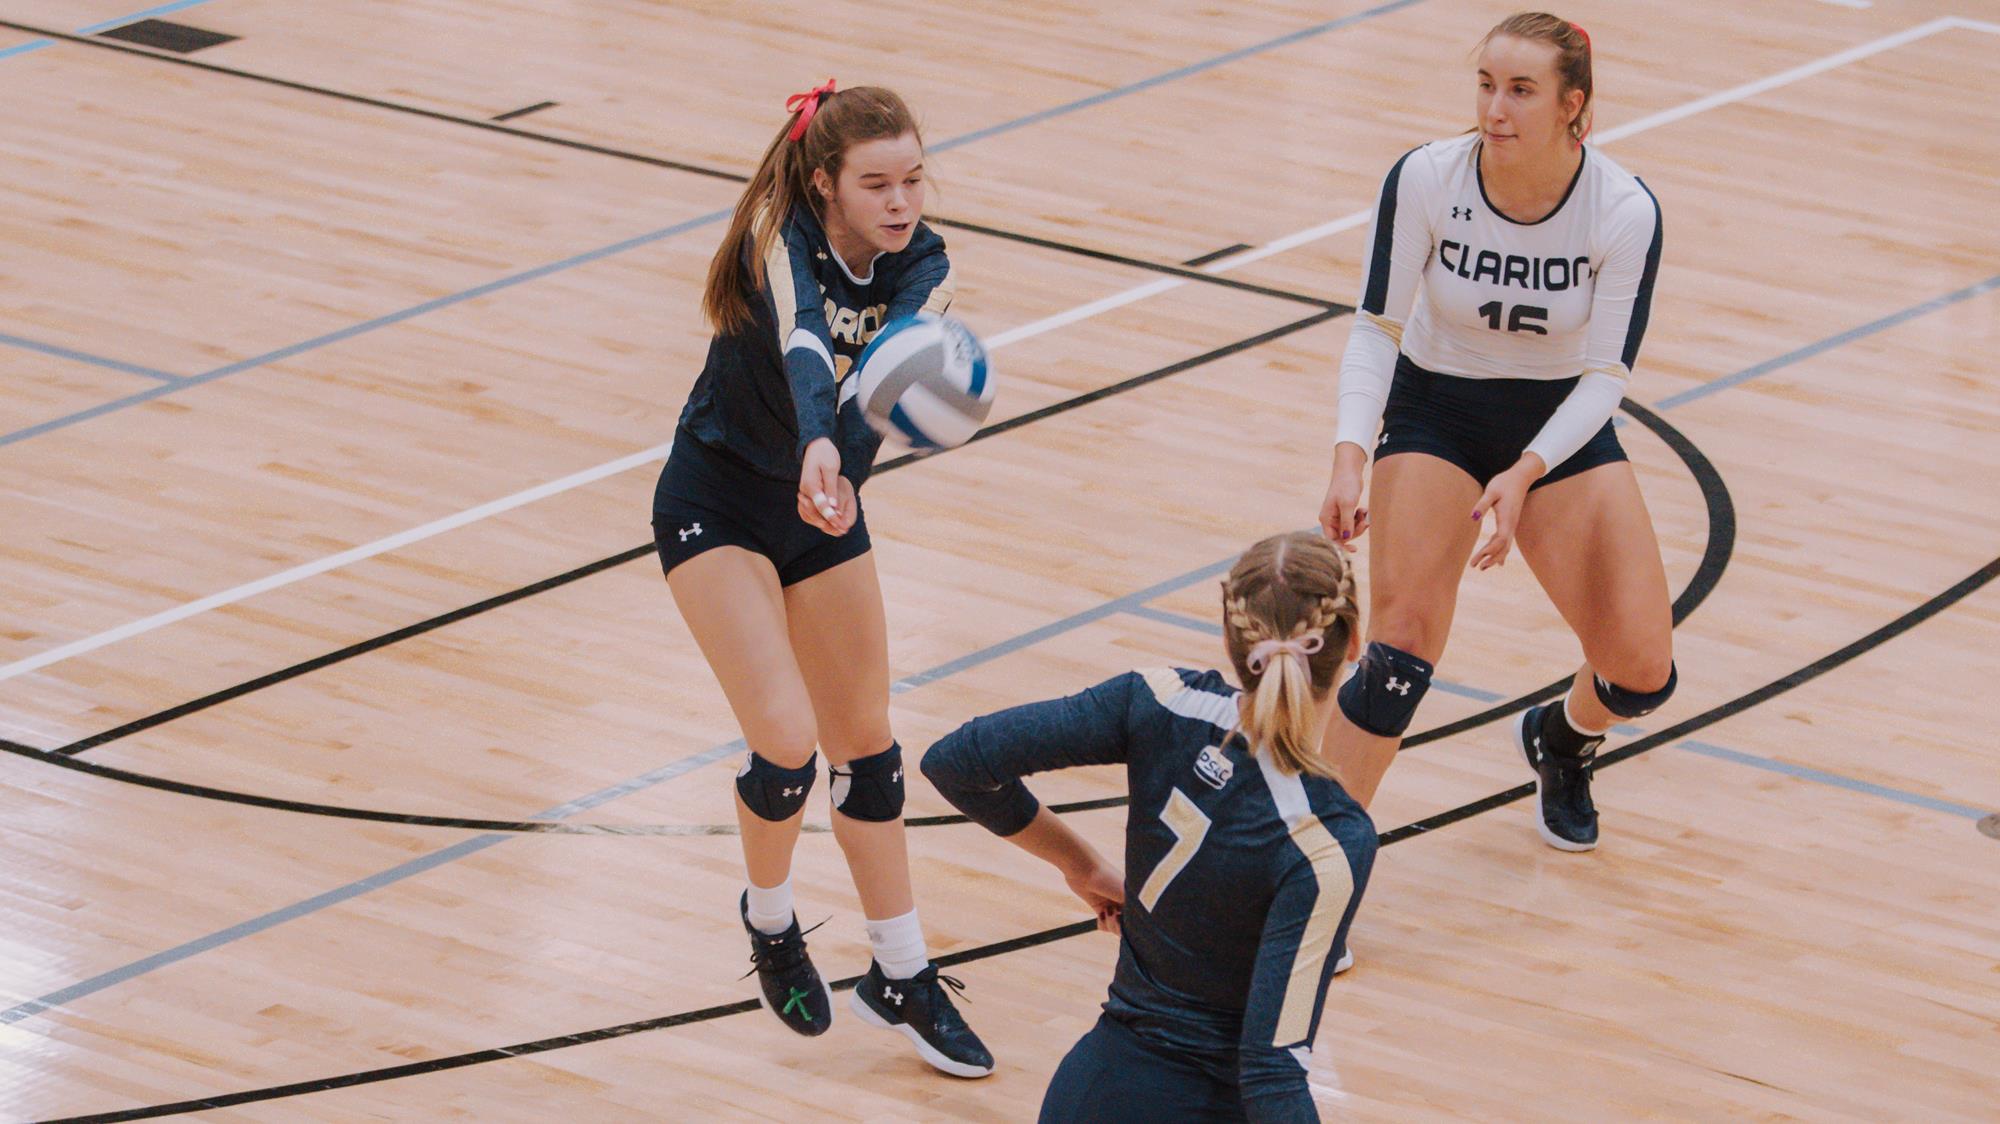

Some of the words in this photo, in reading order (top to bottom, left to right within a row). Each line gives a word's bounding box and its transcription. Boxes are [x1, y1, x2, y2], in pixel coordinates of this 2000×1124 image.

[1440, 239, 1592, 291] CLARION
[1478, 301, 1548, 335] 16
[1138, 786, 1212, 913] 7
